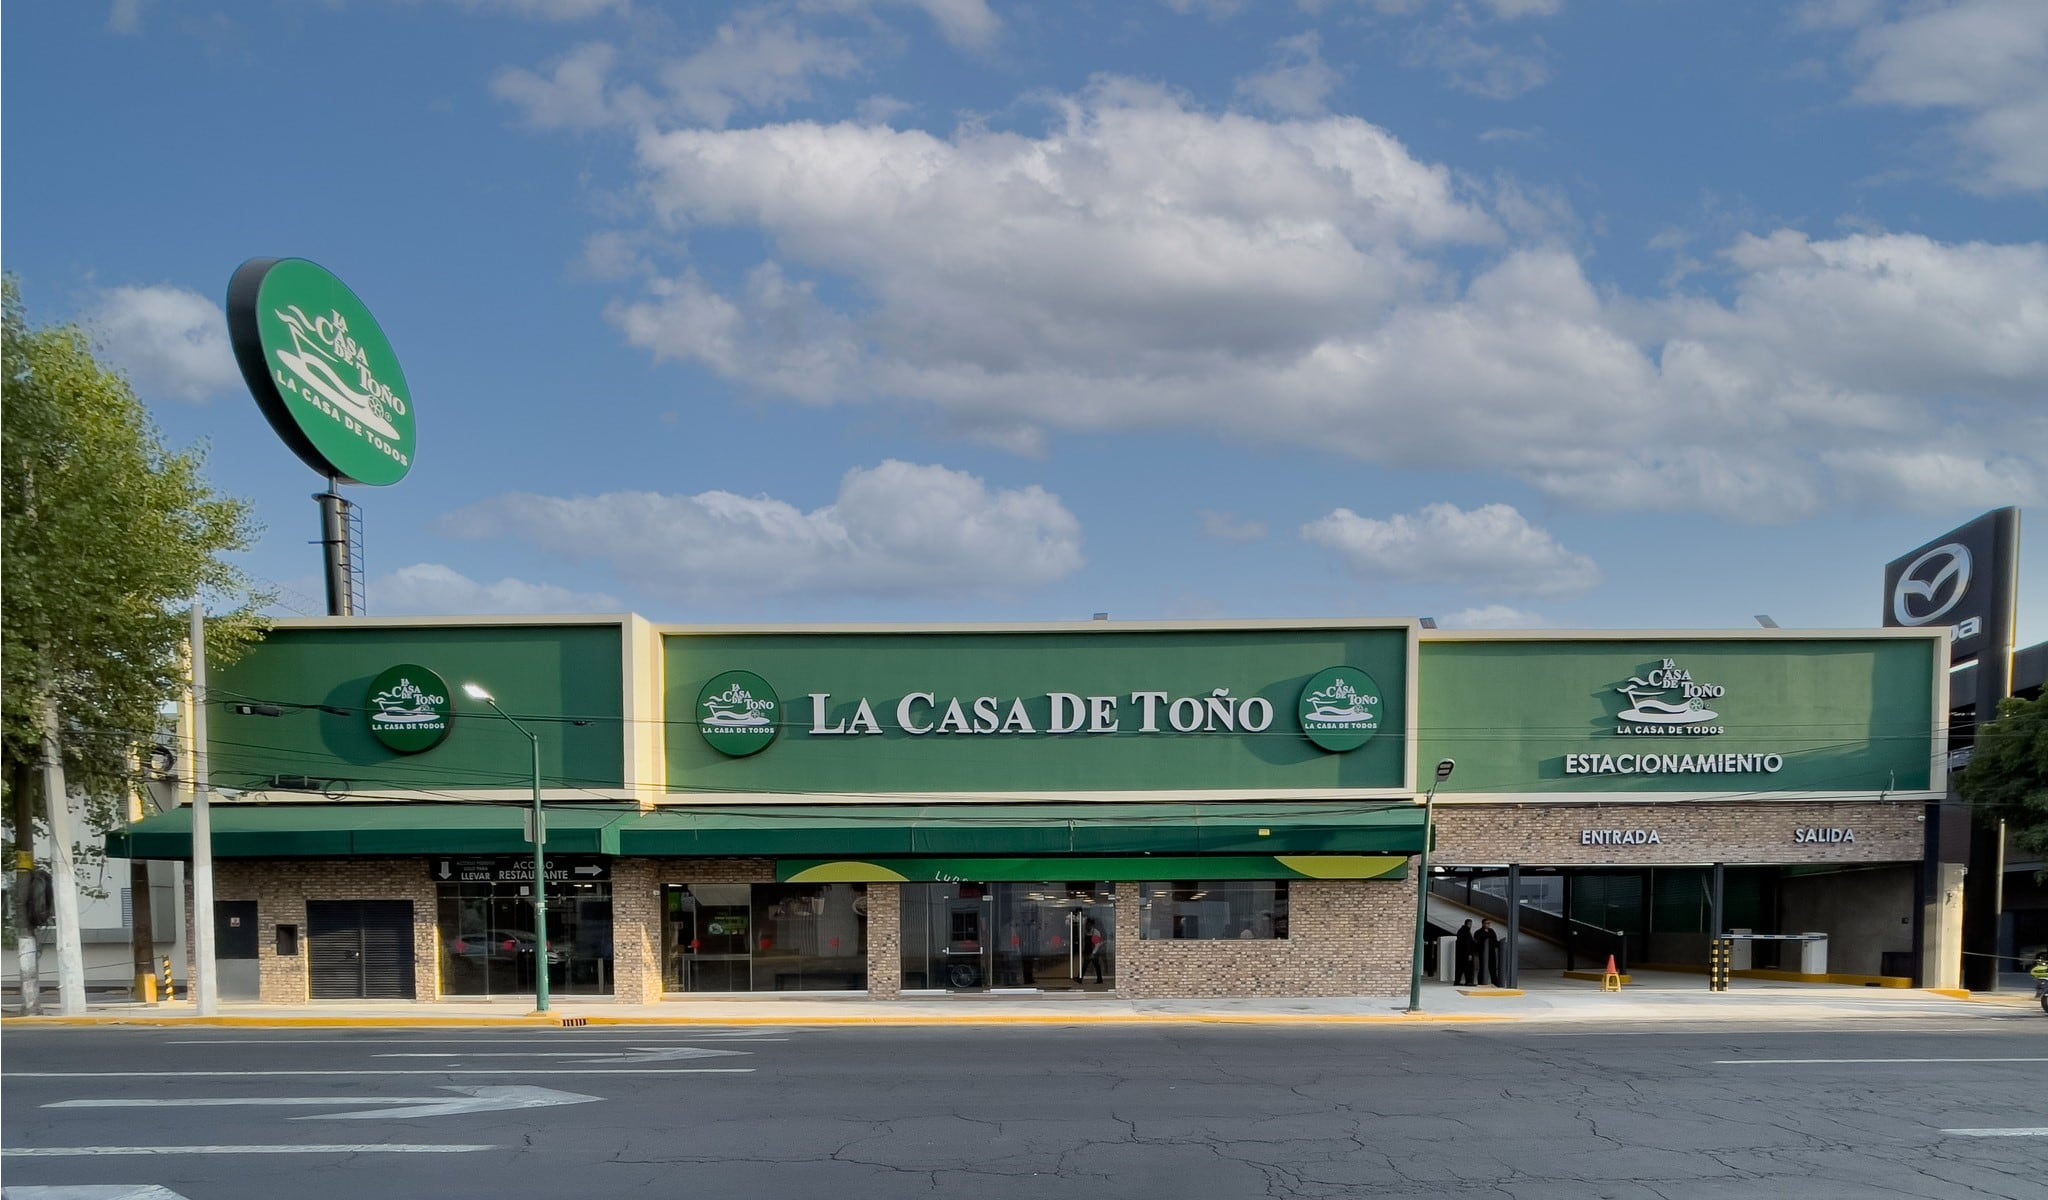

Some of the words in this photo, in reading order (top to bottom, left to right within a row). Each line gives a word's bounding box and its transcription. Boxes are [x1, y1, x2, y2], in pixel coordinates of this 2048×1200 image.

[331, 309, 348, 333] LA
[315, 316, 369, 367] CASA
[334, 339, 353, 366] DE
[356, 361, 406, 415] TOÑO
[277, 370, 297, 393] LA
[302, 388, 340, 421] CASA
[345, 416, 362, 436] DE
[366, 430, 408, 466] TODOS
[1648, 669, 1692, 686] CASA
[1662, 680, 1679, 688] DE
[1681, 682, 1725, 698] TOÑO
[392, 686, 421, 697] CASA
[722, 691, 752, 702] CASA
[1326, 686, 1355, 697] CASA
[414, 694, 444, 705] TOÑO
[744, 699, 774, 710] TOÑO
[1348, 694, 1378, 705] TOÑO
[808, 693, 883, 734] LA
[896, 692, 1036, 734] CASA
[1046, 692, 1119, 733] DE
[1131, 688, 1274, 732] TOÑO
[1617, 726, 1631, 734] LA
[1635, 726, 1664, 734] CASA
[1668, 726, 1683, 734] DE
[1684, 726, 1724, 734] TODOS
[1565, 753, 1783, 774] ESTACIONAMIENTO
[1582, 830, 1660, 844] ENTRADA
[1794, 828, 1855, 843] SALIDA
[513, 861, 554, 869] ACCO
[461, 872, 490, 880] LLEVAR
[499, 870, 568, 880] RESTAUANTE
